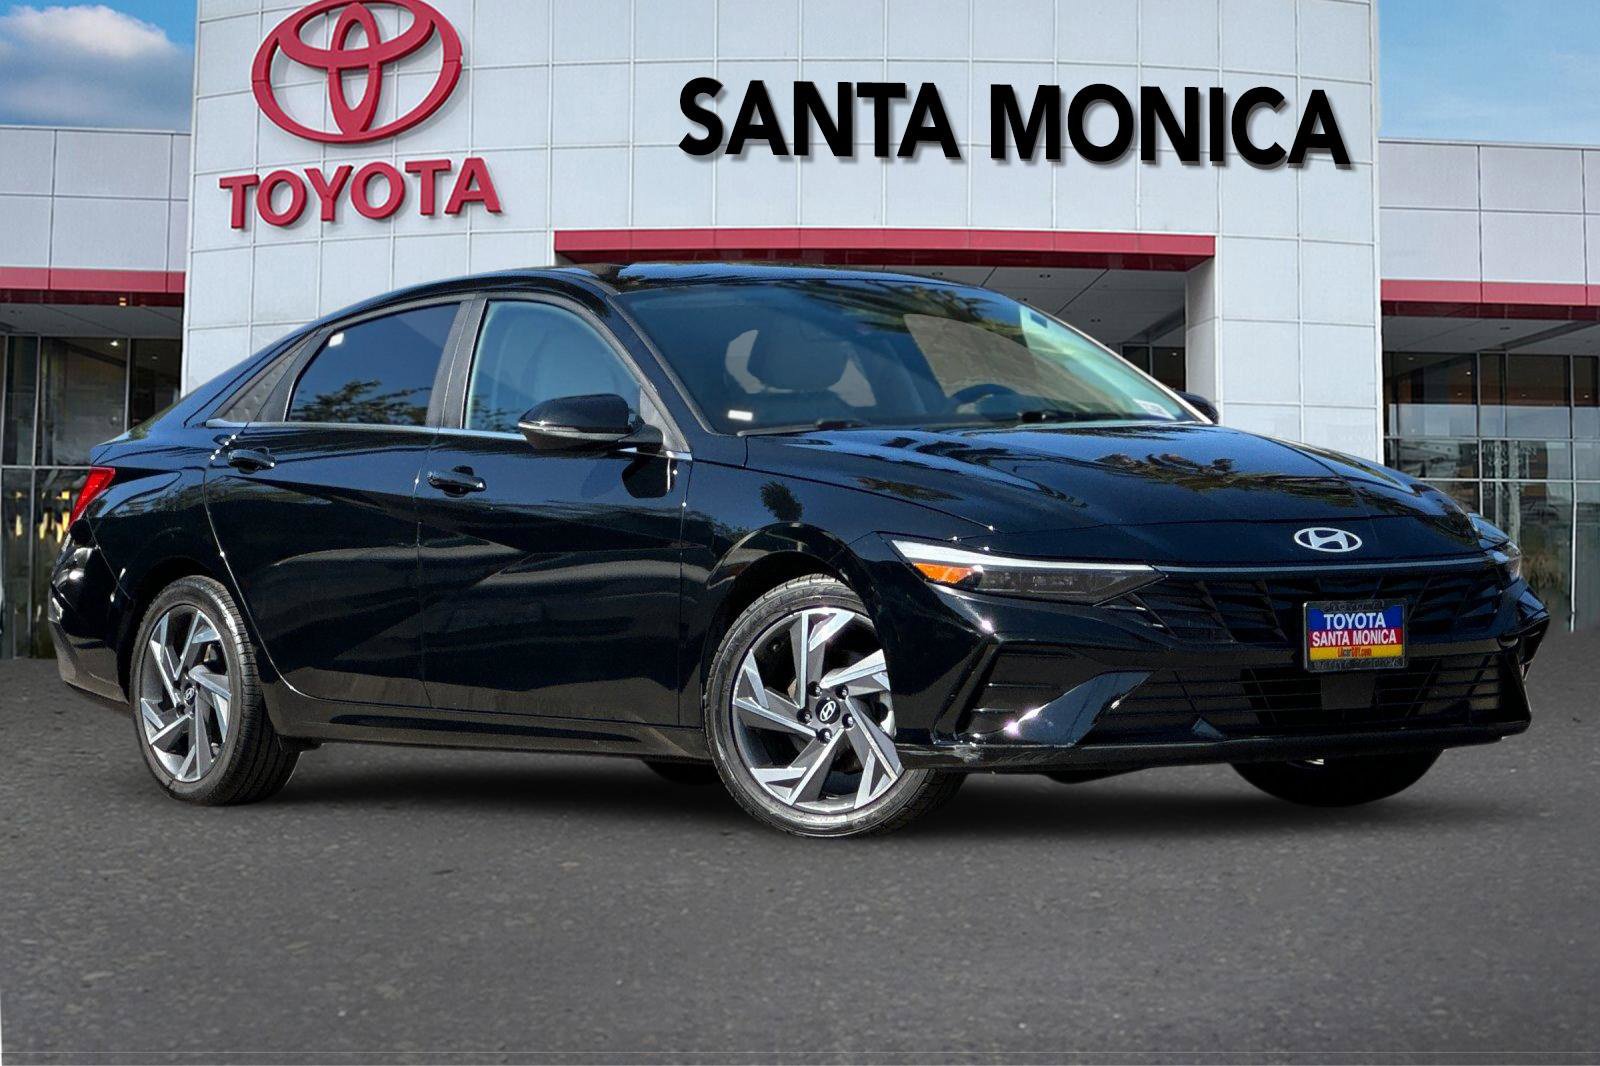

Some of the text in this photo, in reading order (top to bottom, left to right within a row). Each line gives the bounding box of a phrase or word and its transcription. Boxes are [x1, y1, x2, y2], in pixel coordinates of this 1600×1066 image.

[678, 77, 1352, 170] SANTA MONICA
[219, 157, 502, 229] TOYOTA
[1312, 629, 1397, 646] SANTA MONICA
[1323, 612, 1386, 630] TOYOTA
